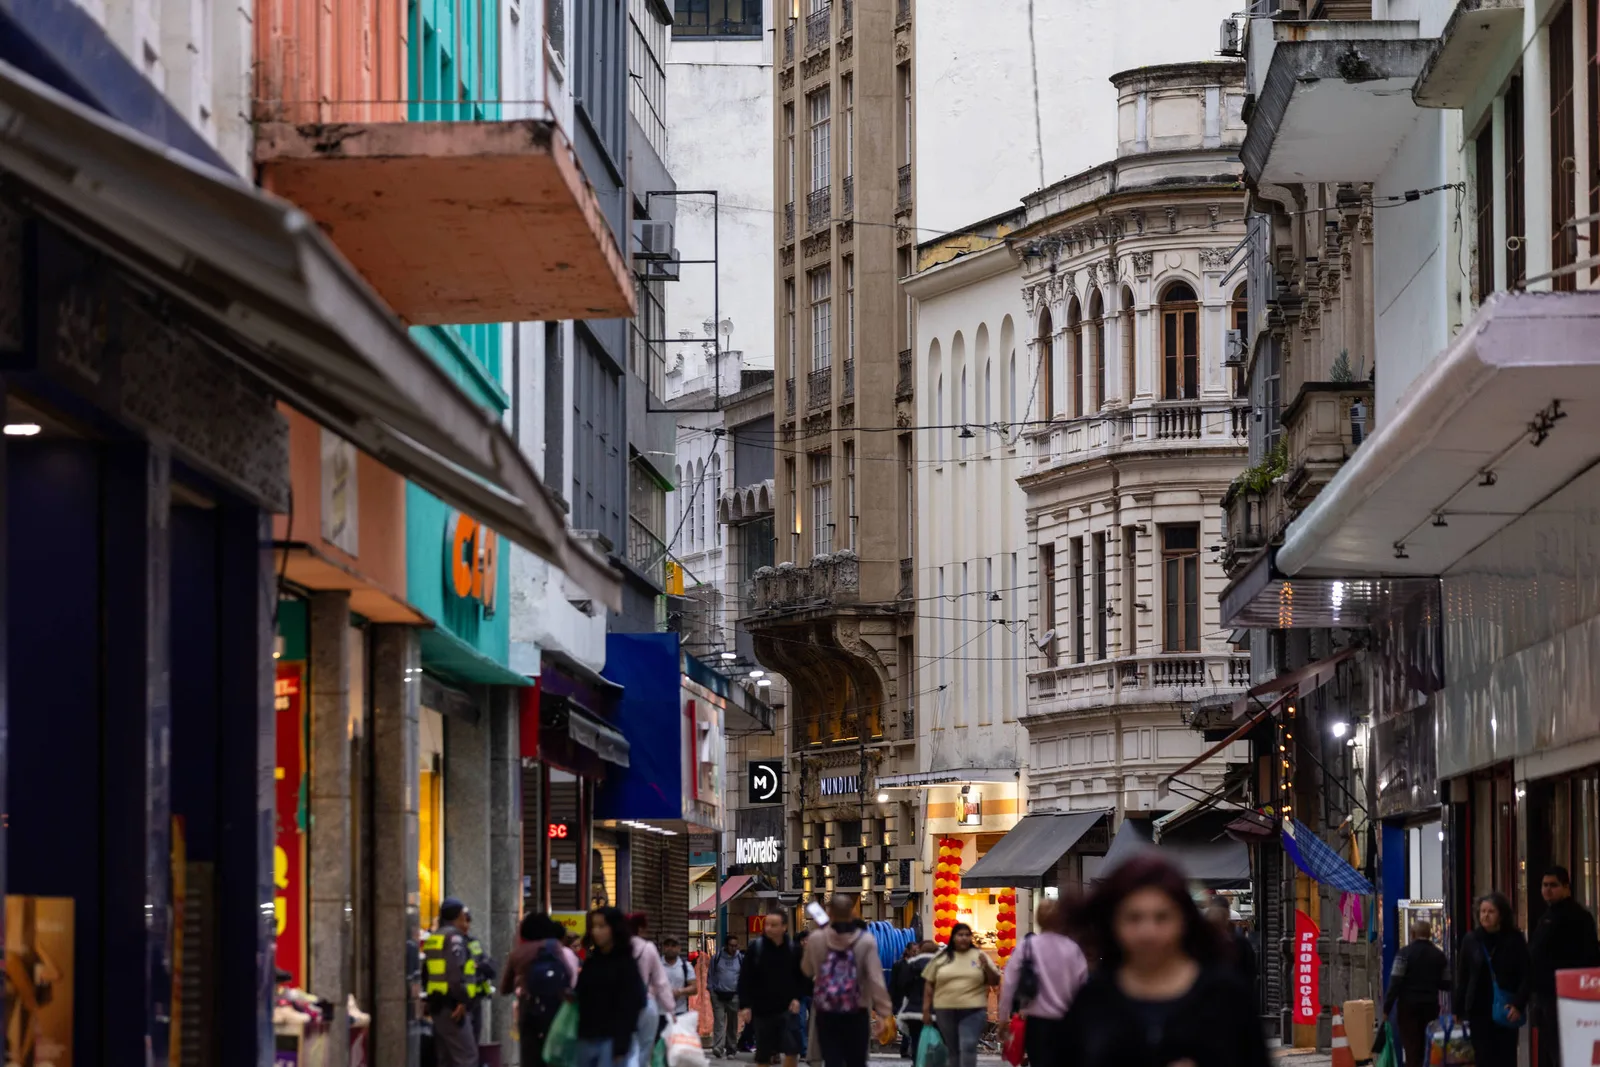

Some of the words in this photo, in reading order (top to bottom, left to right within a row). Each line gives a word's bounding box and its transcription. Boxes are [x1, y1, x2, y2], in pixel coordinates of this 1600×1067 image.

[820, 776, 858, 795] MUNDIAL
[735, 836, 778, 864] McDonald's
[1300, 932, 1313, 1016] PROMOÇÃO
